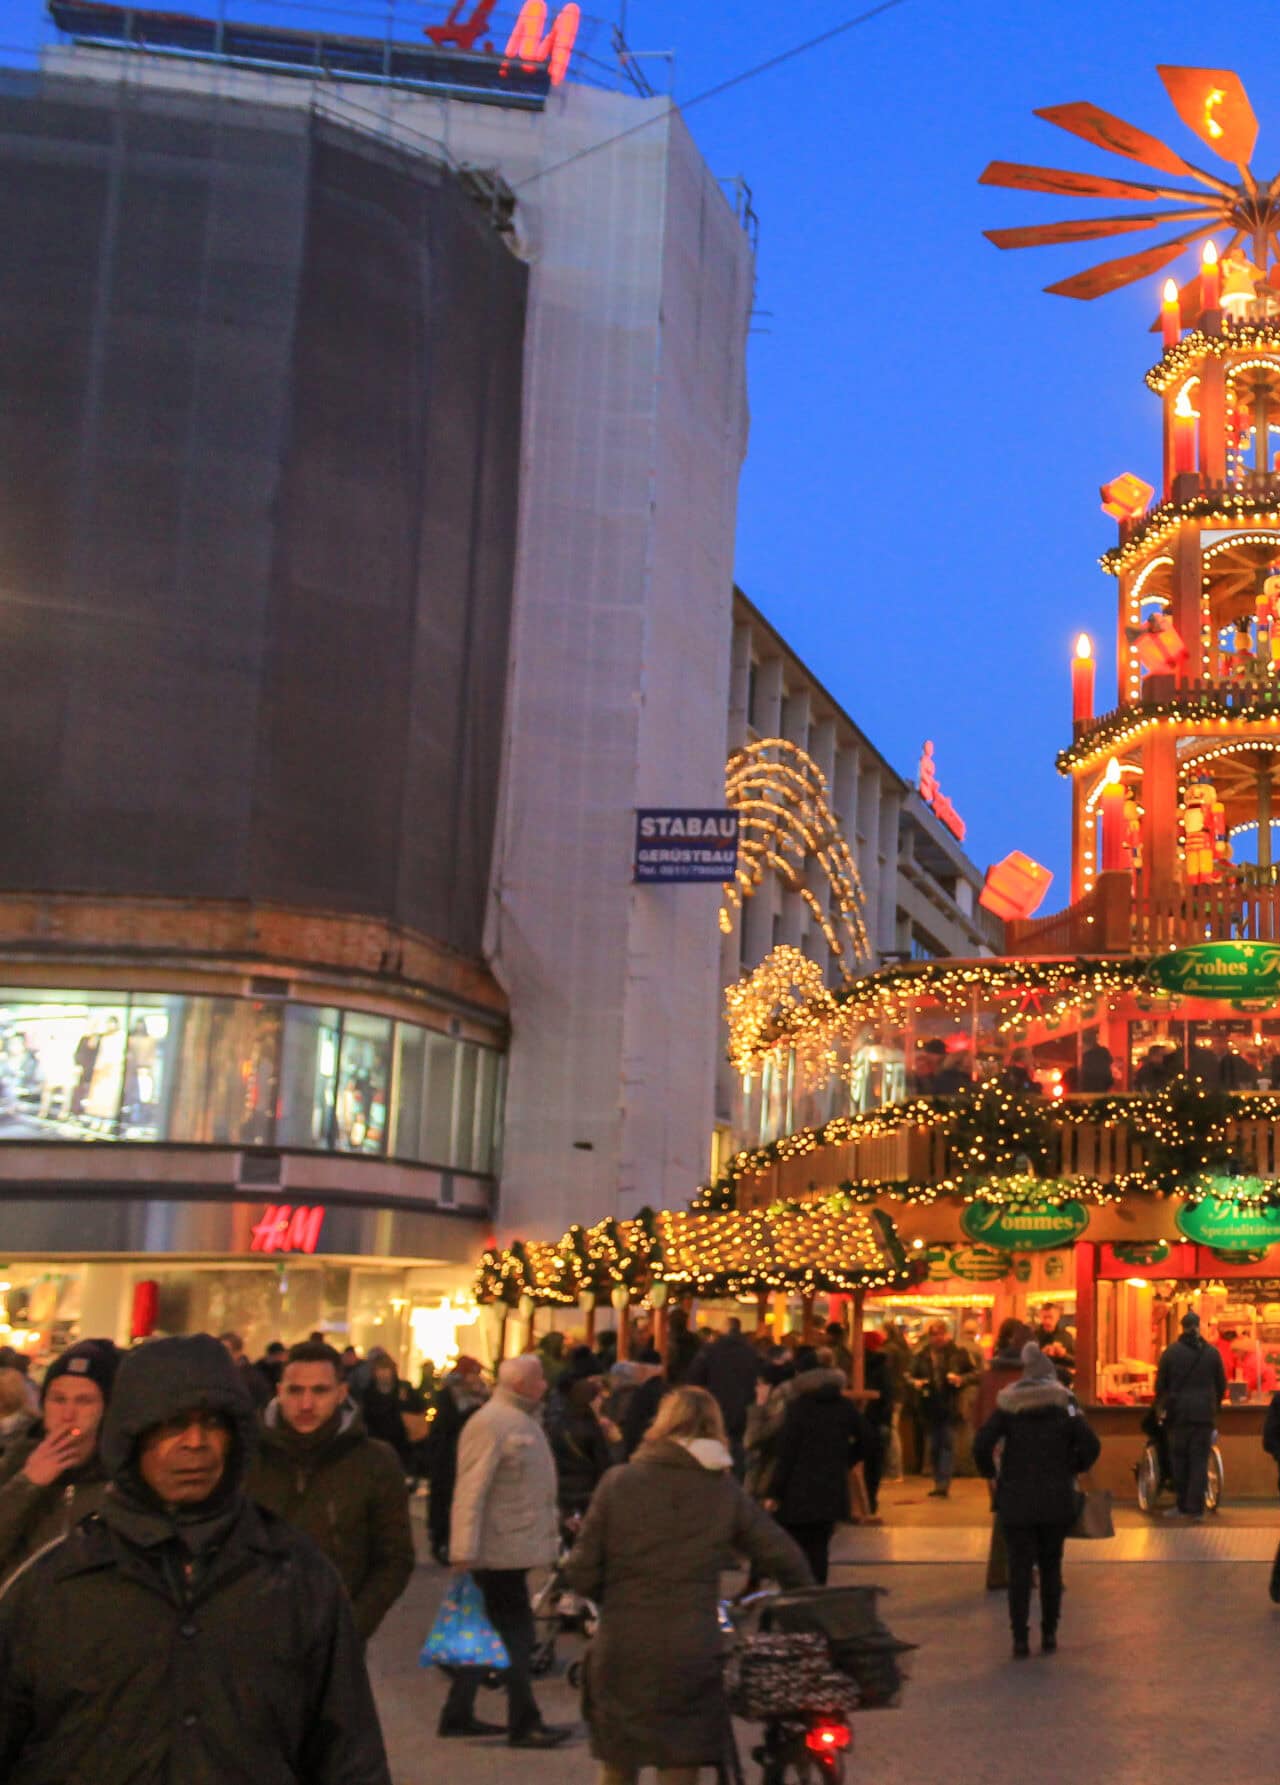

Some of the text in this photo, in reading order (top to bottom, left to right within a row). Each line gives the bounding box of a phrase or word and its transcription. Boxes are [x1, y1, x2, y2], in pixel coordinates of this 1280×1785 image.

[640, 816, 737, 837] STABAU
[638, 848, 736, 863] GERÜSTBAU
[1169, 951, 1249, 977] Frohes
[251, 1204, 325, 1254] H&M
